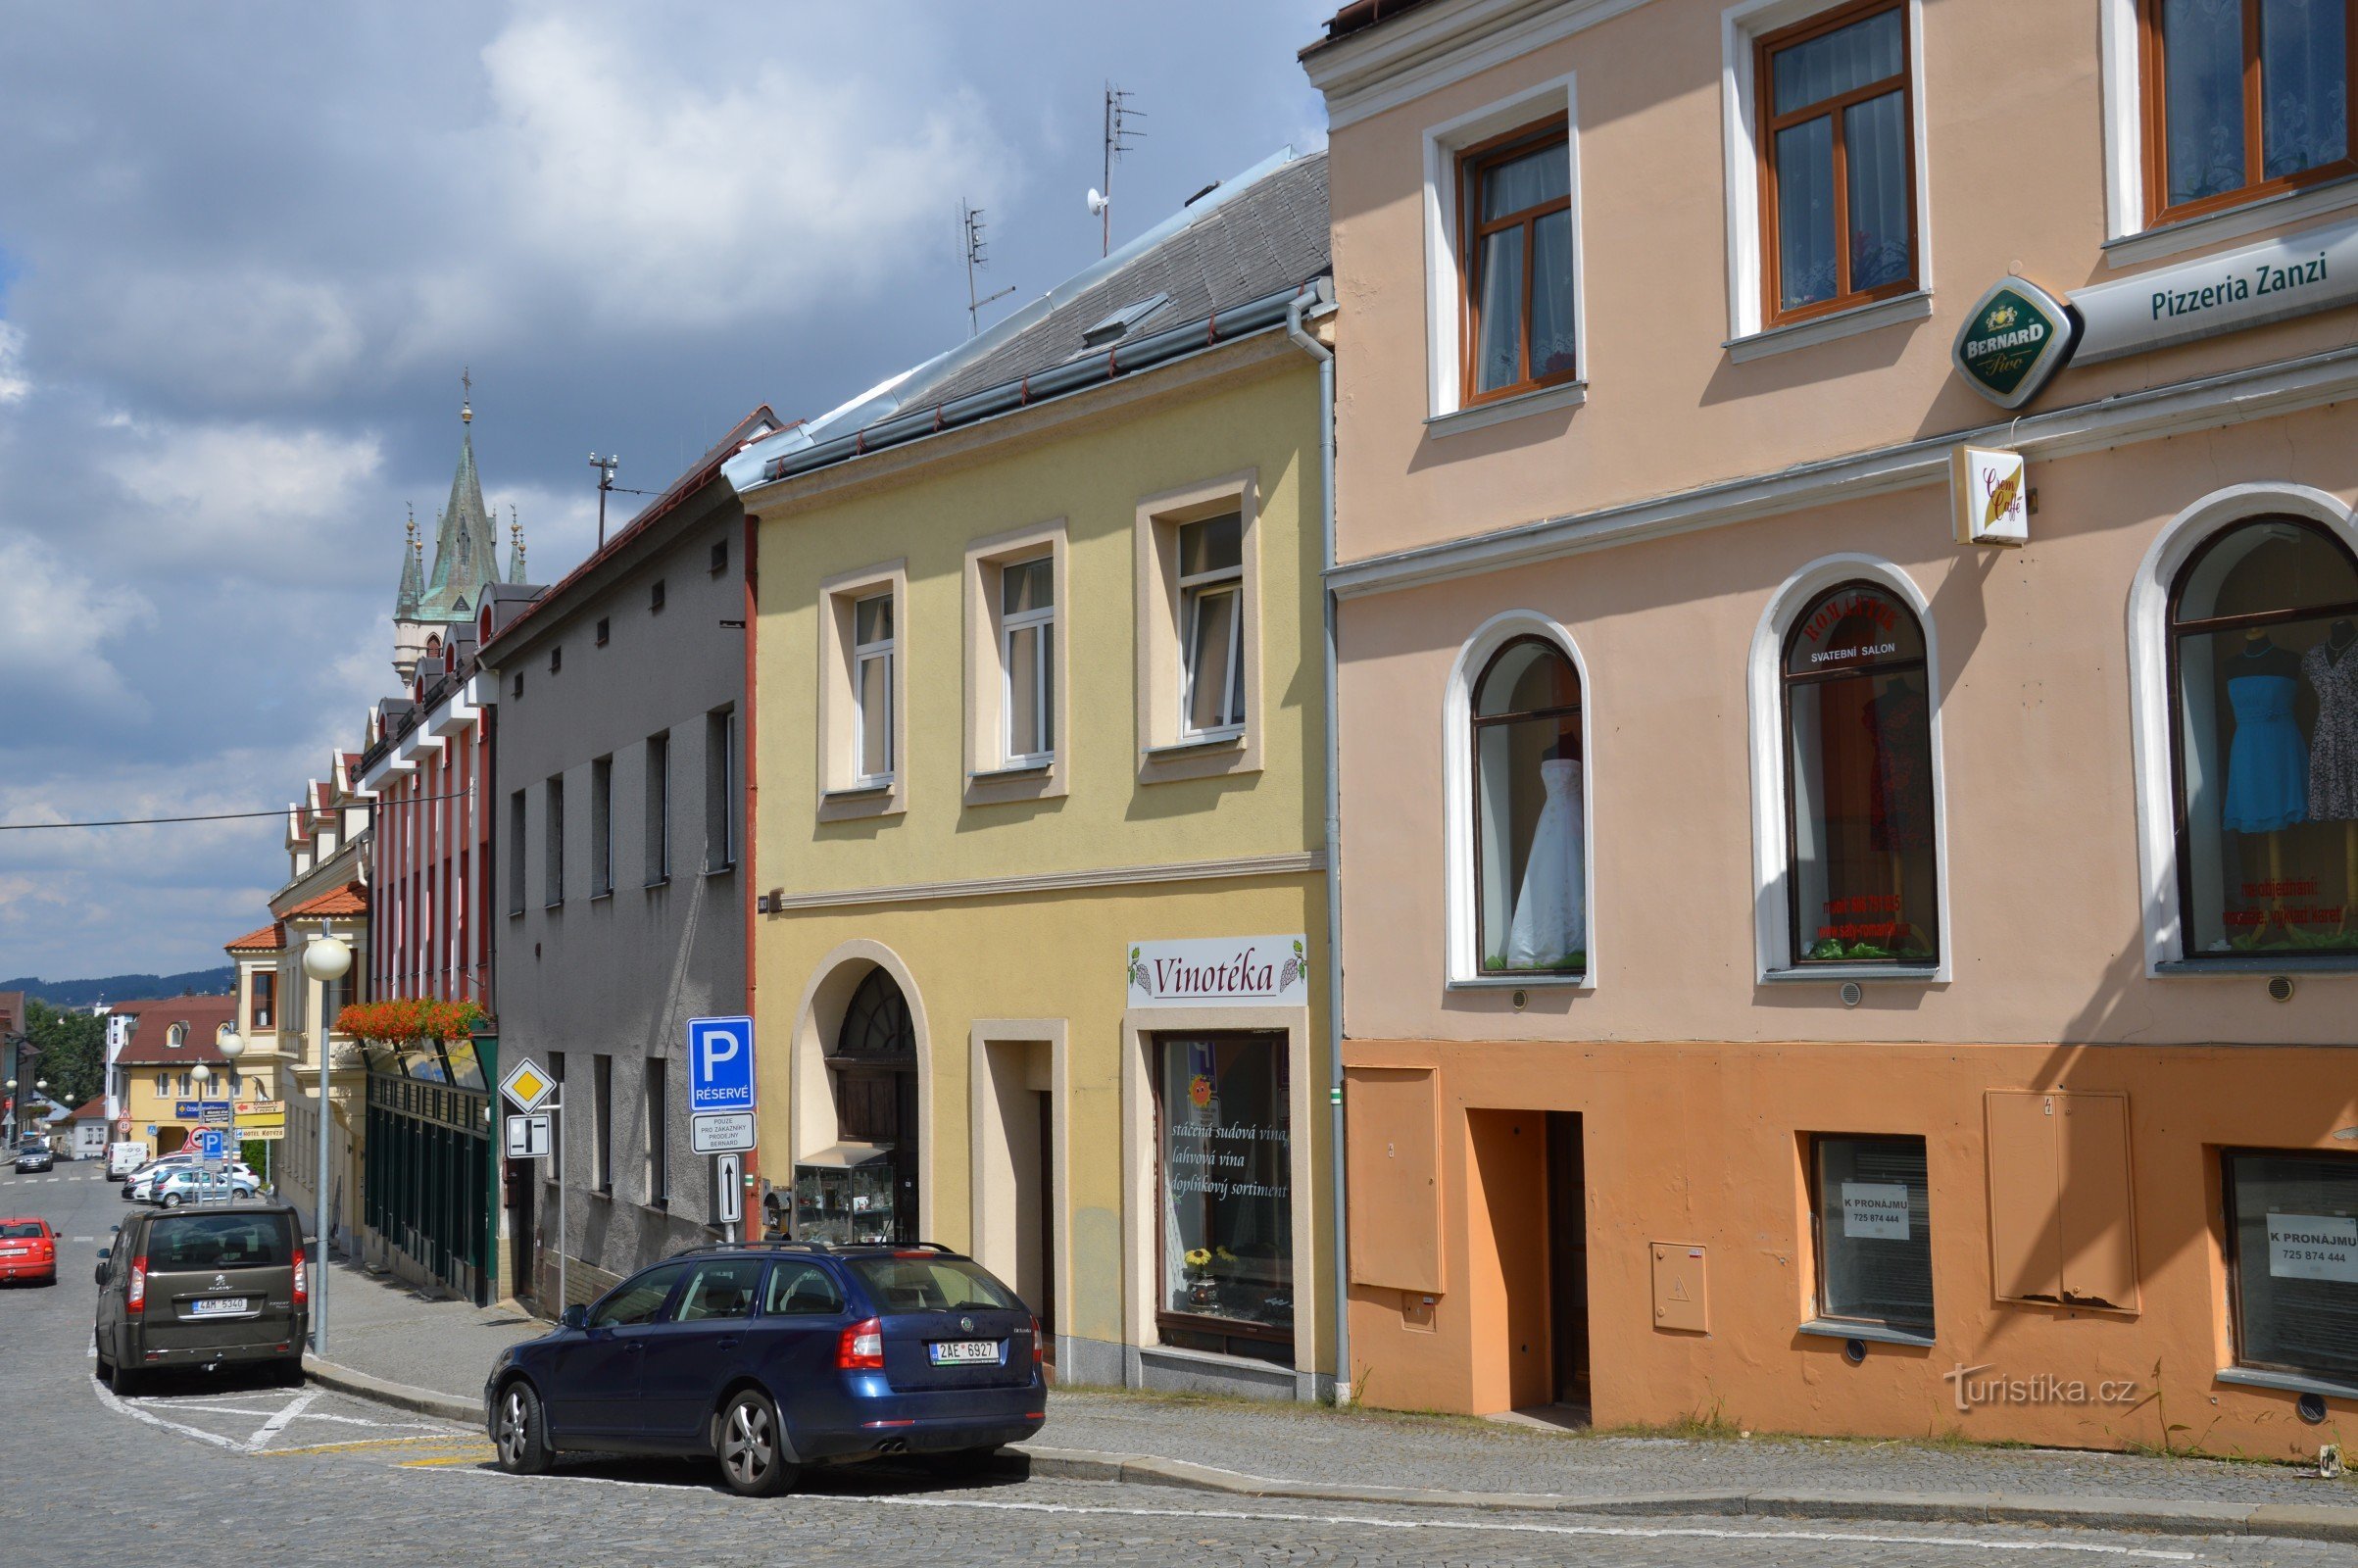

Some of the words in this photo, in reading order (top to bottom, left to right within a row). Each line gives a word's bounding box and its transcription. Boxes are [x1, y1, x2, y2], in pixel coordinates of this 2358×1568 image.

[2151, 274, 2249, 320] Pizzeria
[2256, 251, 2328, 296] Zanzi
[1967, 322, 2044, 360] BERNARD
[1983, 467, 2015, 498] Crem
[1811, 646, 1857, 662] SVATEBNÍ
[1861, 643, 1895, 656] SALON
[1154, 947, 1273, 993] Vinotéka
[703, 1031, 739, 1082] P
[696, 1085, 749, 1101] RÉSERVÉ
[714, 1124, 747, 1133] ZÁKAZNÍKY
[1171, 1121, 1213, 1138] stáčená
[1215, 1121, 1255, 1140] sudová
[207, 1135, 219, 1151] P
[1172, 1147, 1215, 1165] lahvová
[1219, 1151, 1245, 1167] vína
[1171, 1174, 1228, 1200] doplňkový
[1231, 1181, 1288, 1199] sortiment
[1844, 1199, 1852, 1207] K
[1854, 1199, 1908, 1209] PRONÁJMU
[1853, 1213, 1868, 1222] 725
[1870, 1214, 1884, 1223] 874
[2270, 1232, 2281, 1242] K
[2284, 1233, 2357, 1247] PRONÁJMU
[2283, 1250, 2302, 1260] 725
[2305, 1250, 2325, 1261] 874
[2328, 1252, 2346, 1263] 444
[200, 1299, 218, 1310] 4AM
[221, 1298, 244, 1309] 5340
[941, 1344, 960, 1359] 2AE
[967, 1343, 994, 1358] 6927
